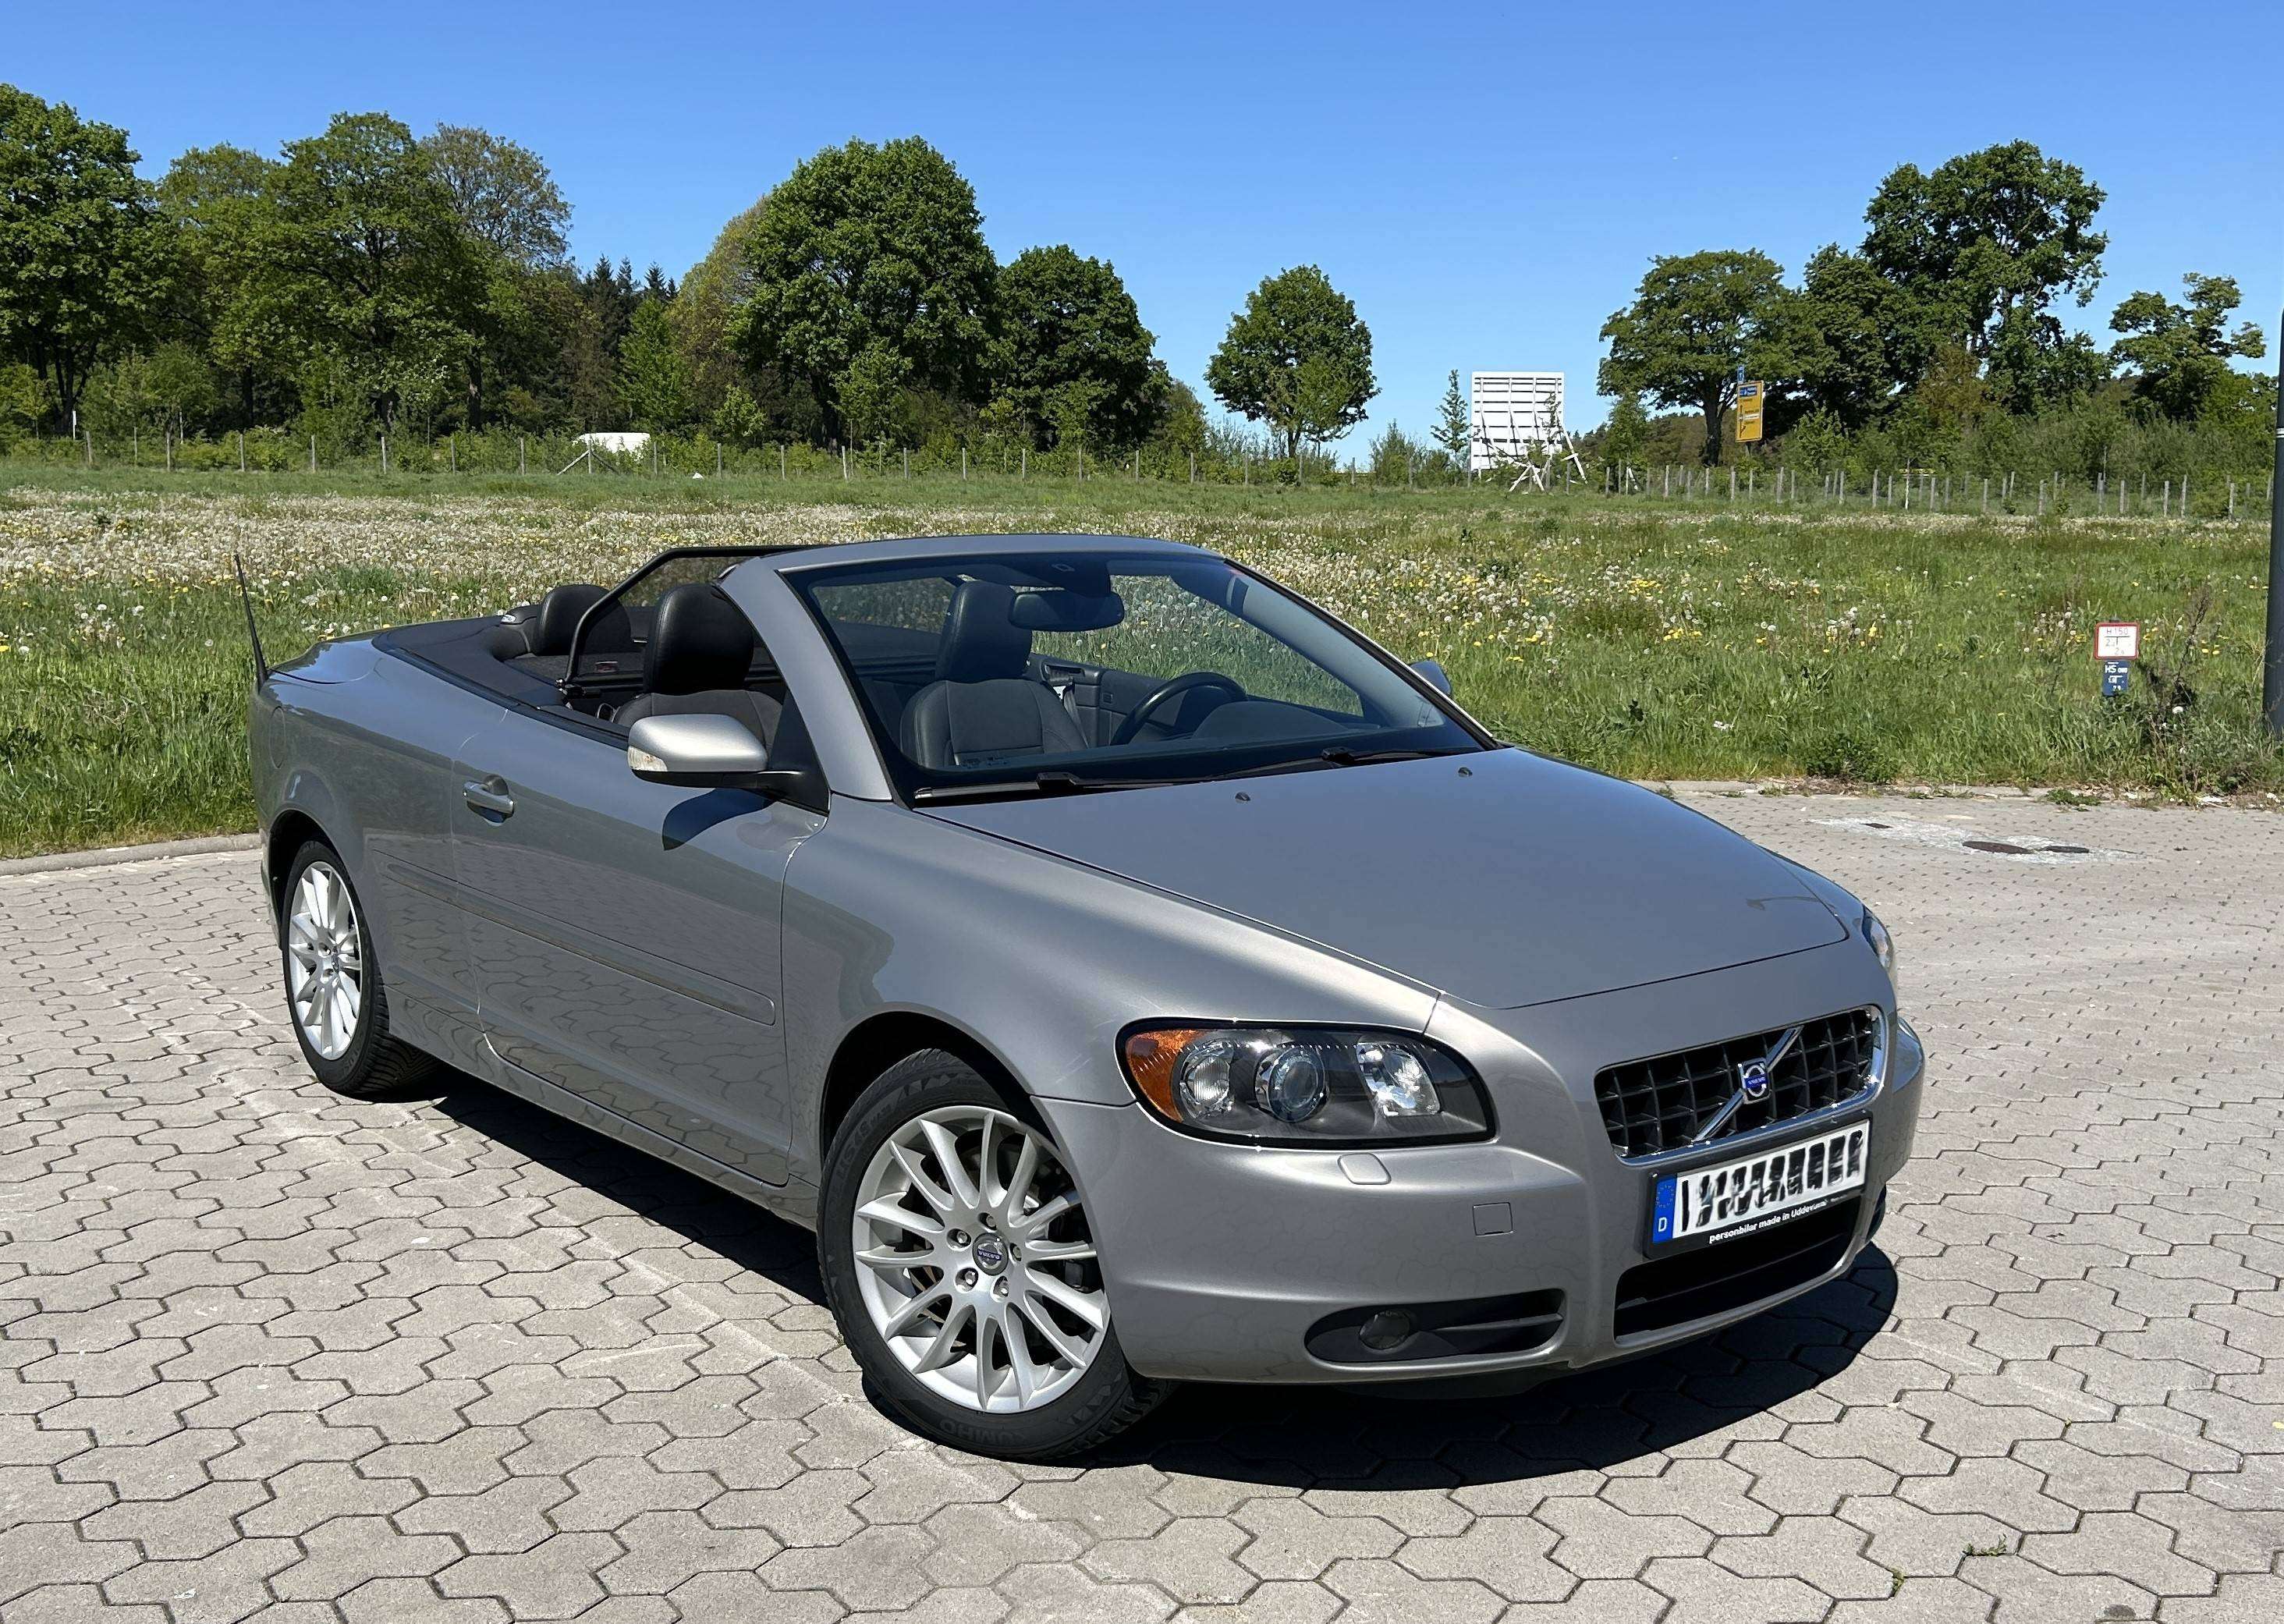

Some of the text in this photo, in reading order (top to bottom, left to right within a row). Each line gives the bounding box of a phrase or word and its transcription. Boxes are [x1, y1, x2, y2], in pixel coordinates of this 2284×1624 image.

[1658, 1217, 1667, 1232] D
[1758, 1215, 1781, 1229] made
[1782, 1212, 1790, 1221] in
